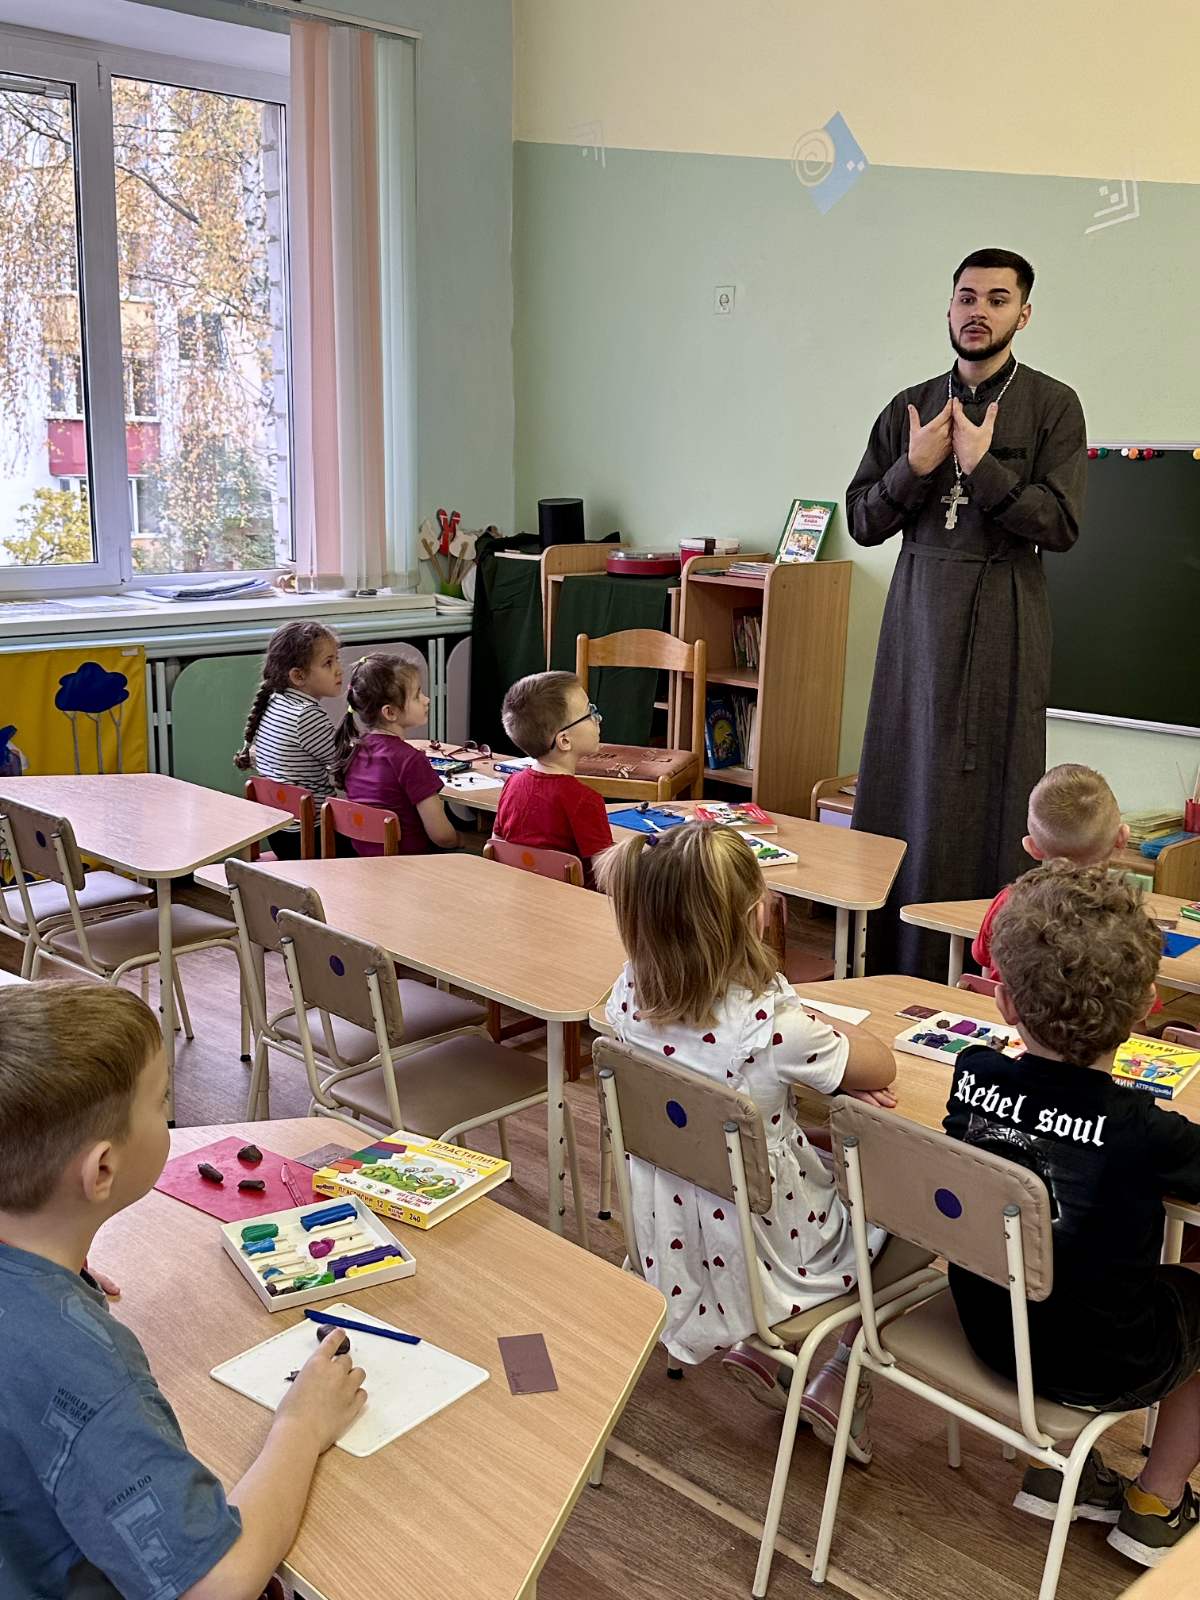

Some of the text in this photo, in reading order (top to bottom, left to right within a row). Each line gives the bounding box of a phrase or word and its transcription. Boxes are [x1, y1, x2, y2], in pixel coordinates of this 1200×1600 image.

[954, 1070, 1107, 1147] Rebel soul
[432, 1143, 500, 1165] ПЛАСТИЛИН
[376, 1199, 384, 1209] 12
[409, 1213, 421, 1223] 240
[57, 1387, 88, 1410] WORLD
